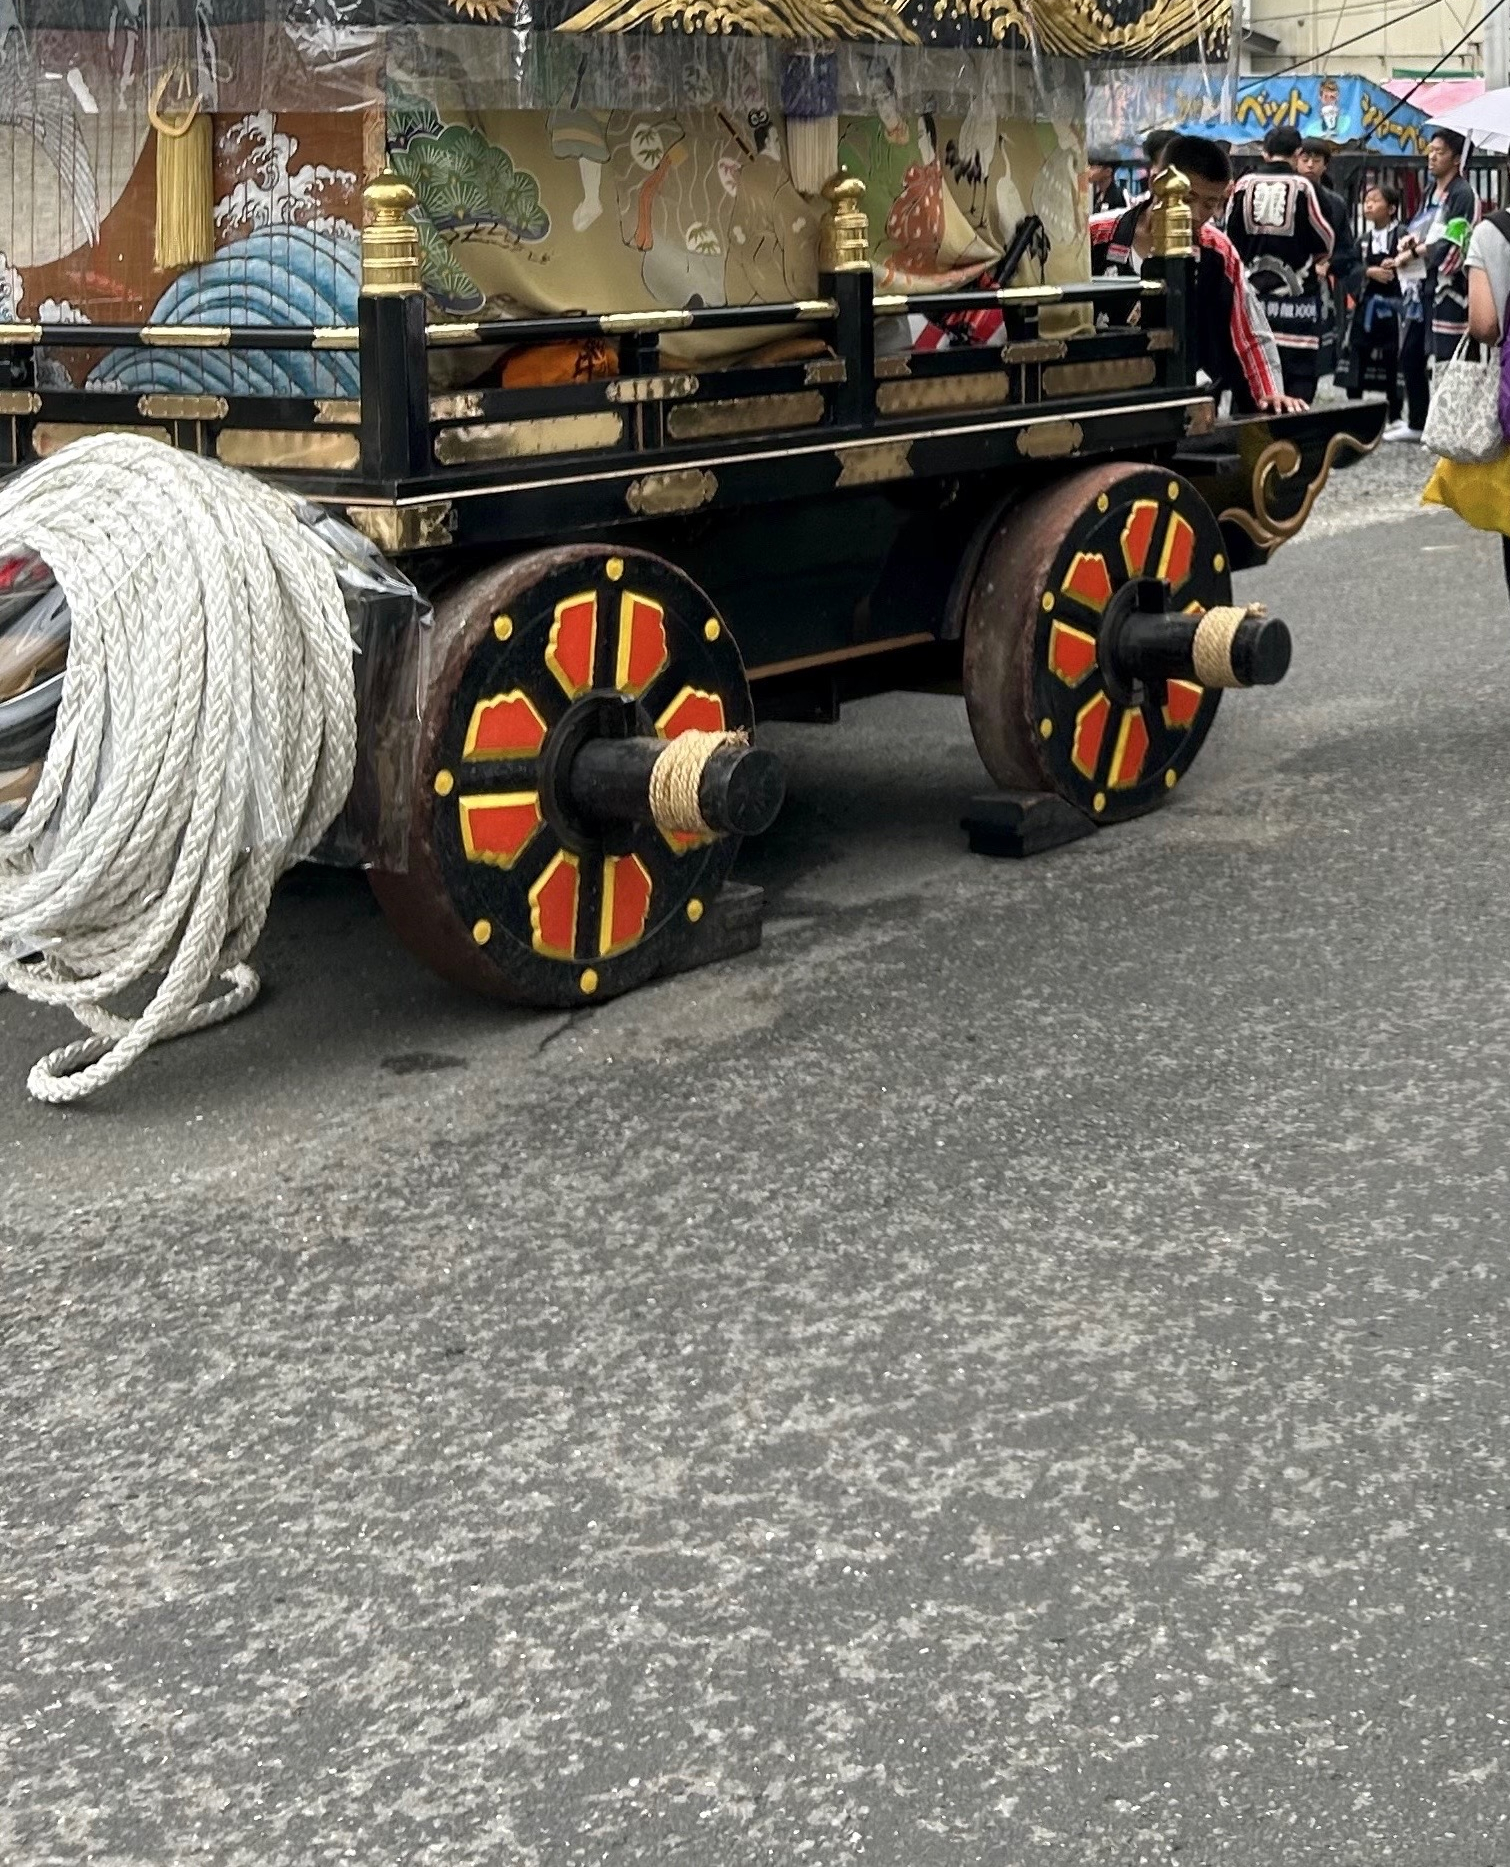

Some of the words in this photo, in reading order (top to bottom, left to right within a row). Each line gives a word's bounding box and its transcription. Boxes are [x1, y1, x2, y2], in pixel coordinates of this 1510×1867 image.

[1361, 92, 1430, 156] シャーベッ
